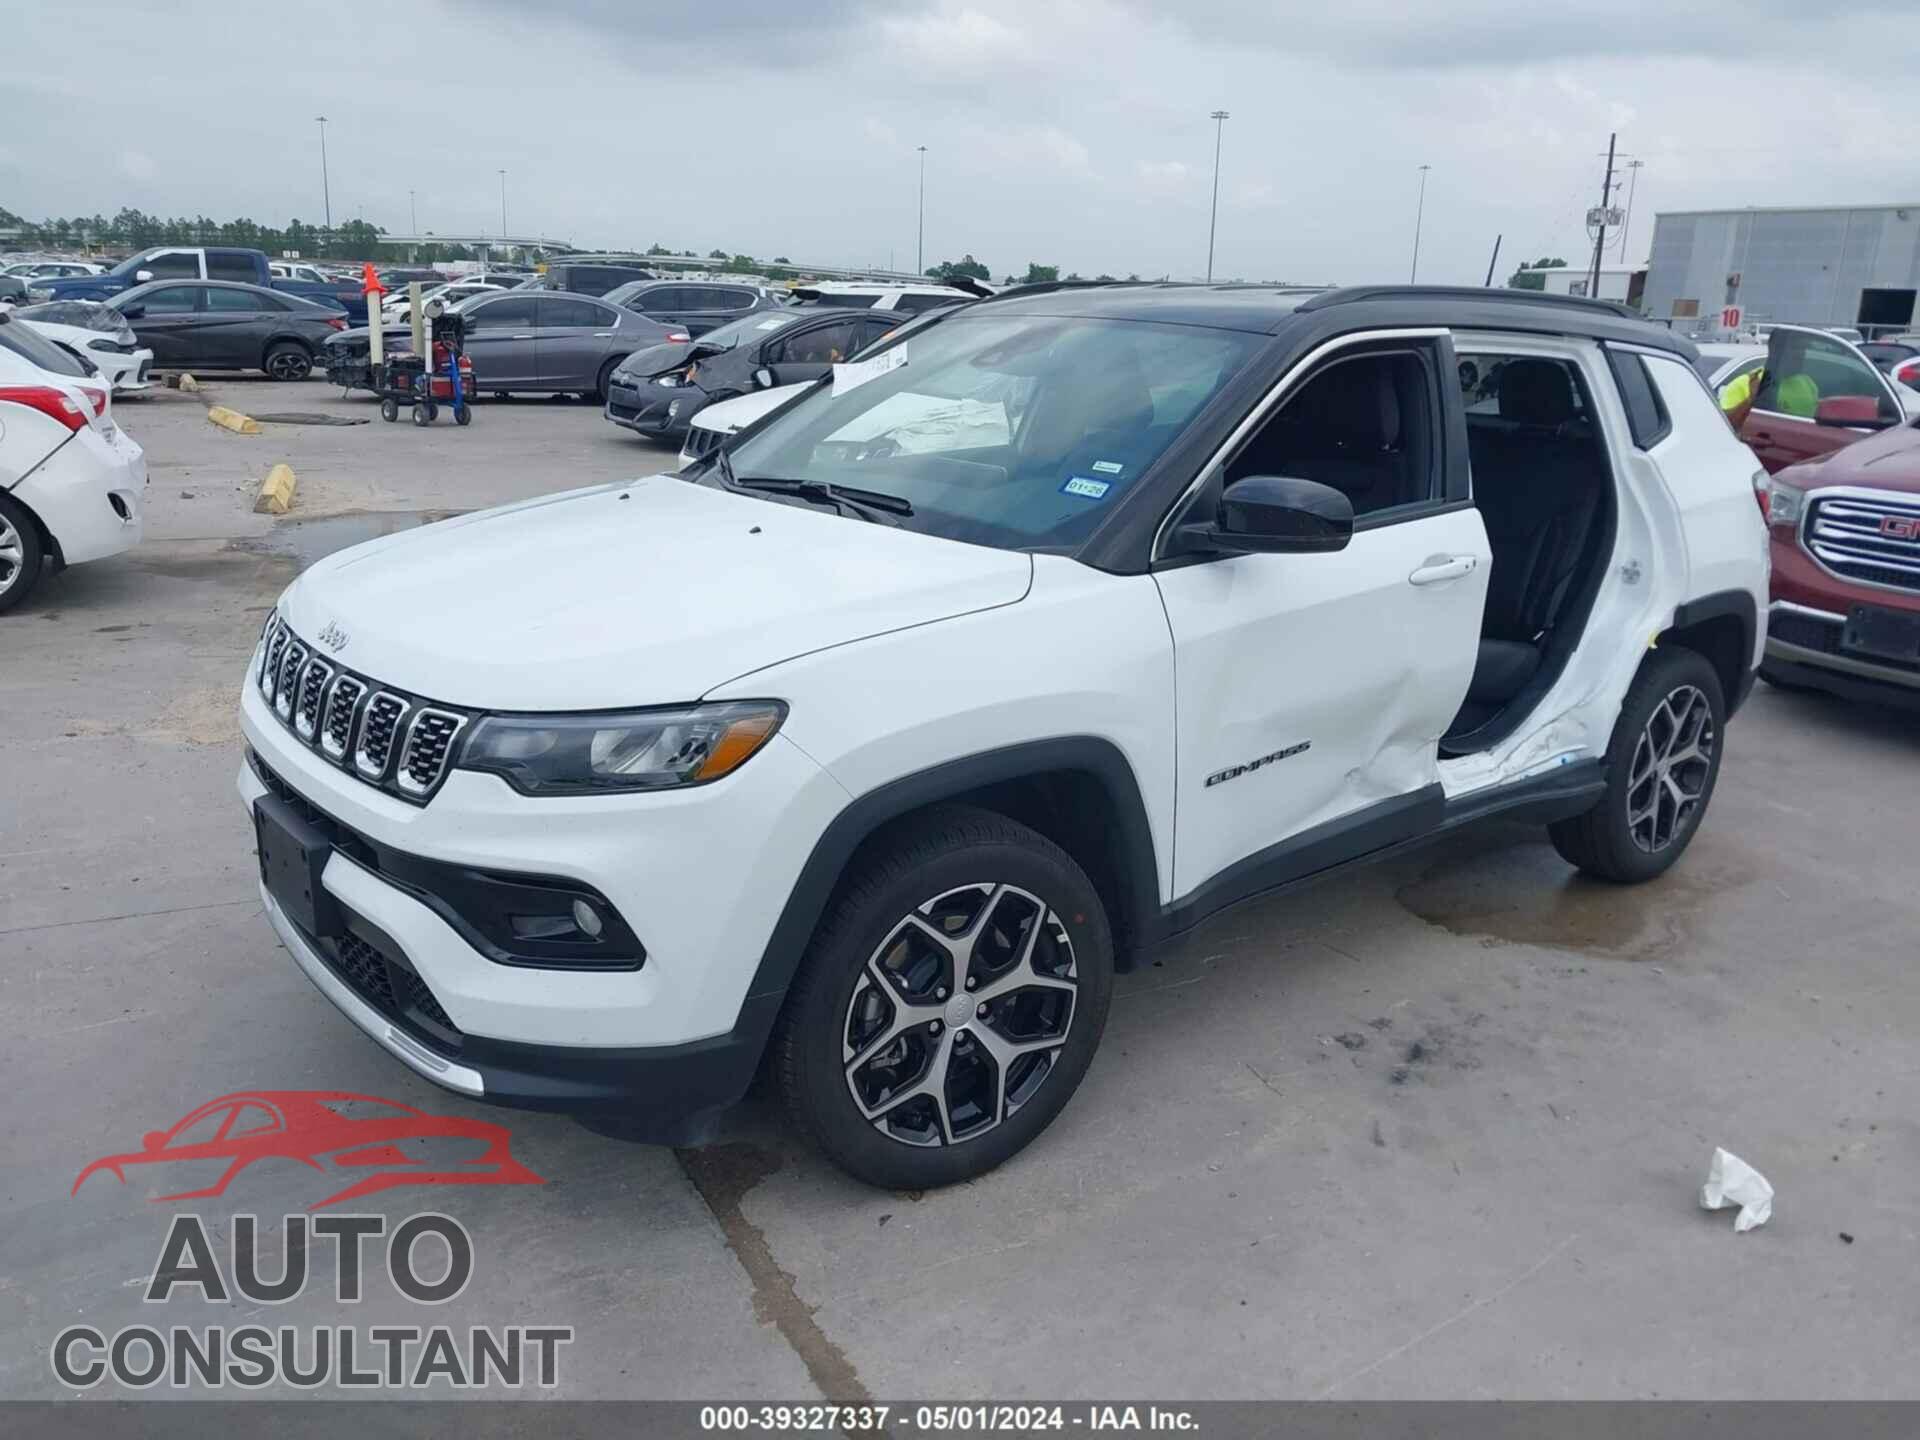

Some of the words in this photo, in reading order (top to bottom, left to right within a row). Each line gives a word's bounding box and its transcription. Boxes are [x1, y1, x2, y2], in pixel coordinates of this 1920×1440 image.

[1722, 308, 1740, 328] 10
[317, 617, 349, 652] Jeep
[1205, 740, 1311, 787] COMPASS
